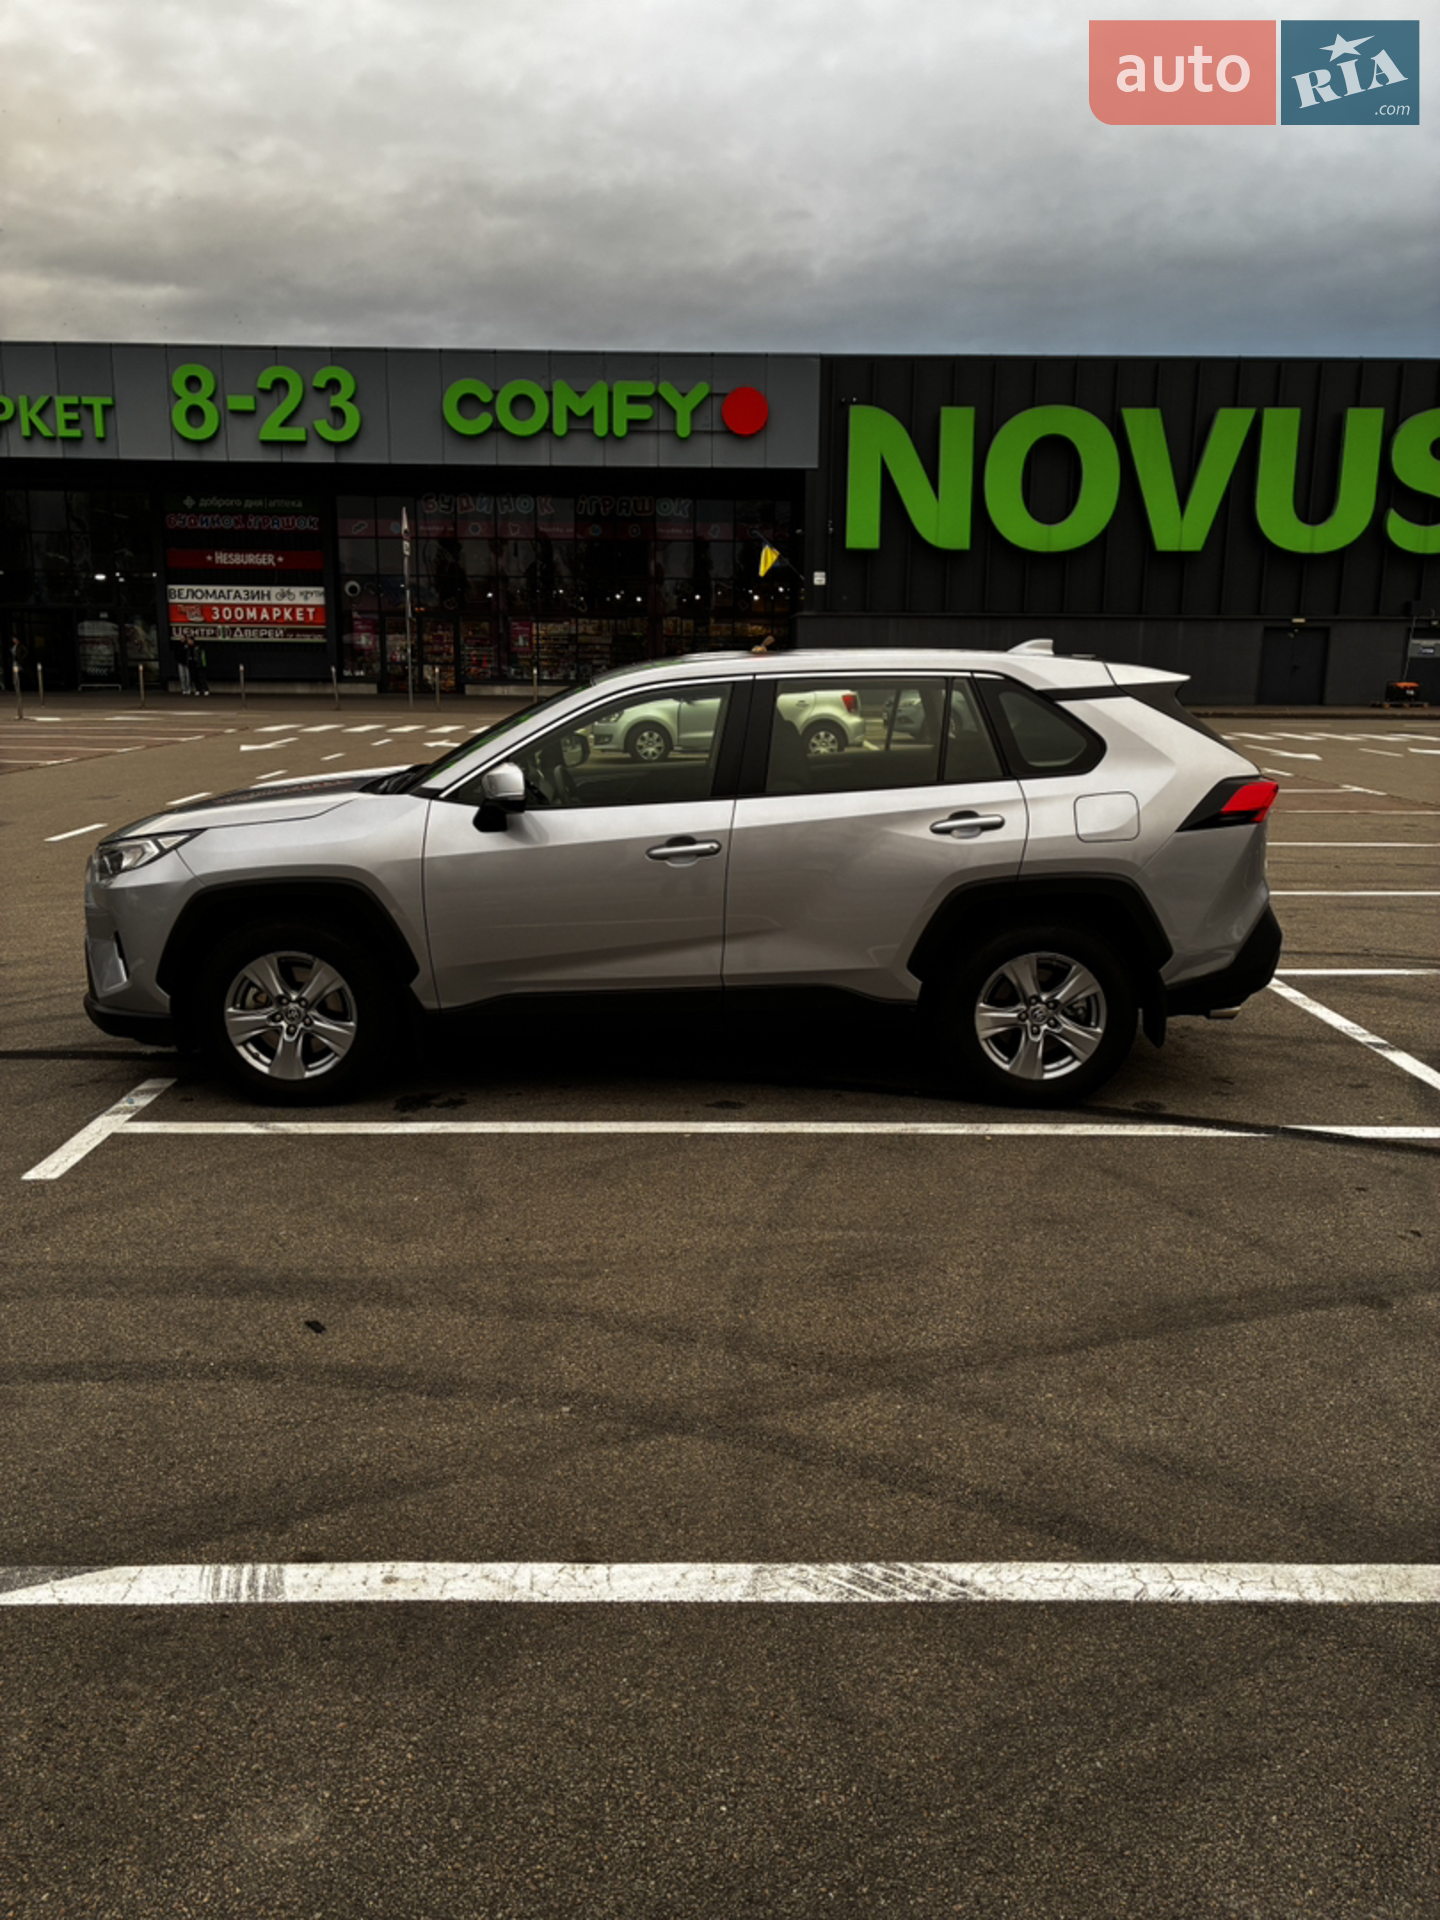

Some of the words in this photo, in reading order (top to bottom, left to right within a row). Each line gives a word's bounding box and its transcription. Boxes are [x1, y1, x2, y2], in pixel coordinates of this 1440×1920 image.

[170, 364, 361, 442] 8-23
[441, 379, 712, 438] COMFY
[214, 552, 277, 567] HESBURGER
[168, 588, 271, 601] ВЕЛОМАГАЗИН
[211, 607, 316, 622] ЗООМАРКЕТ
[171, 627, 215, 638] ЦЕНТР
